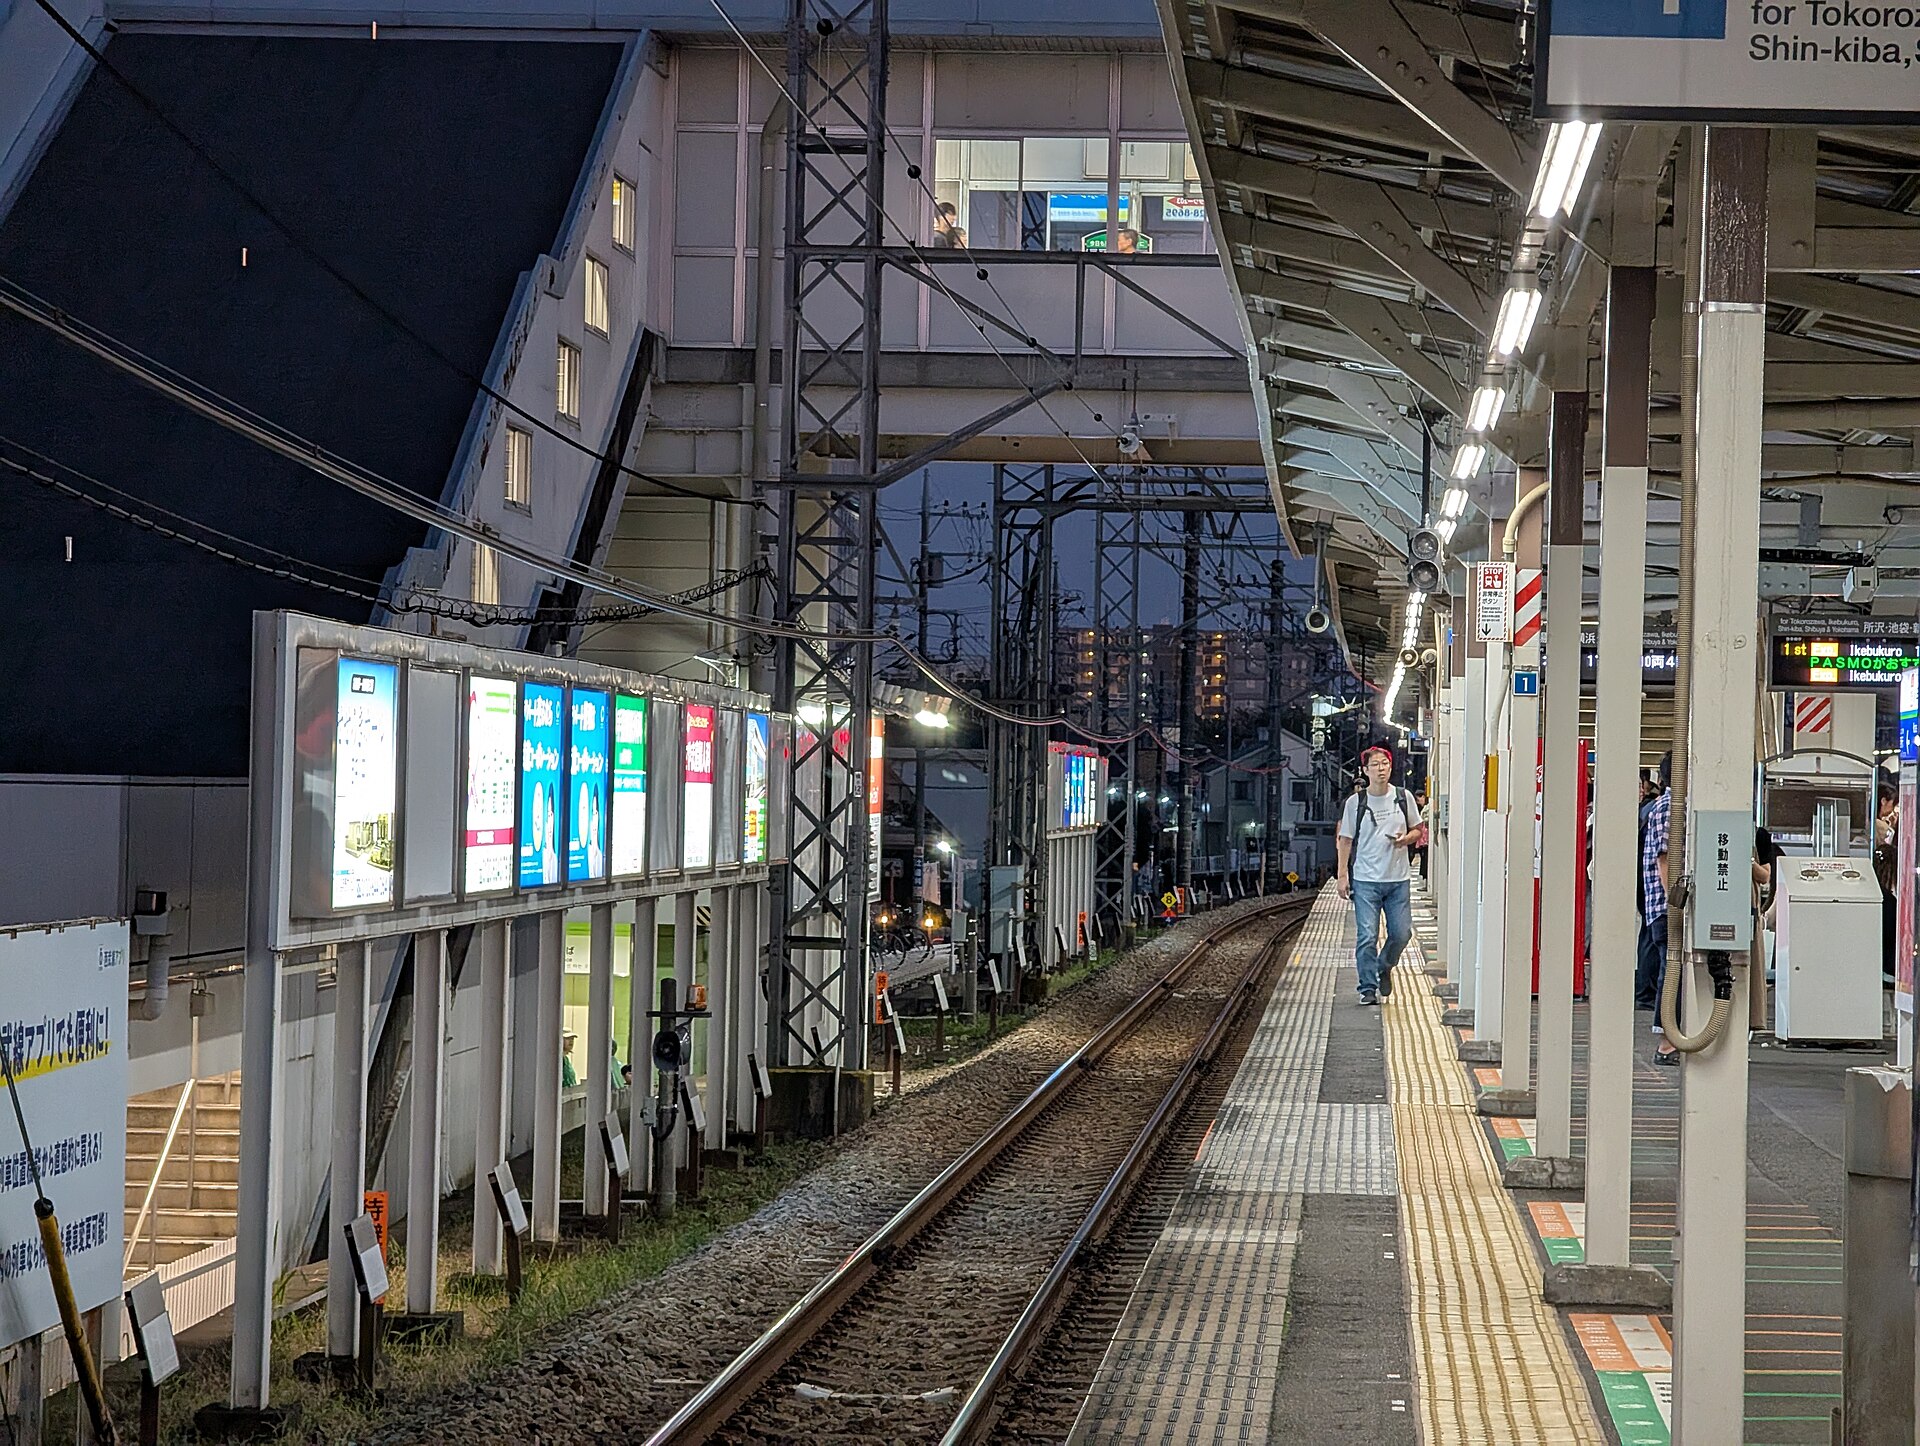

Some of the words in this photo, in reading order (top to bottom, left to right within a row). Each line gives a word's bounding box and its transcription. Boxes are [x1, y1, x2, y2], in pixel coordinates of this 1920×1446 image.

[1751, 0, 1796, 25] for
[1749, 34, 1920, 69] Shin-kiba,
[1850, 644, 1903, 657] Ikebukuro
[1849, 670, 1902, 682] Ikebukuro
[1522, 677, 1530, 692] 1
[1717, 833, 1729, 891] 移動禁止
[1166, 895, 1173, 904] 8
